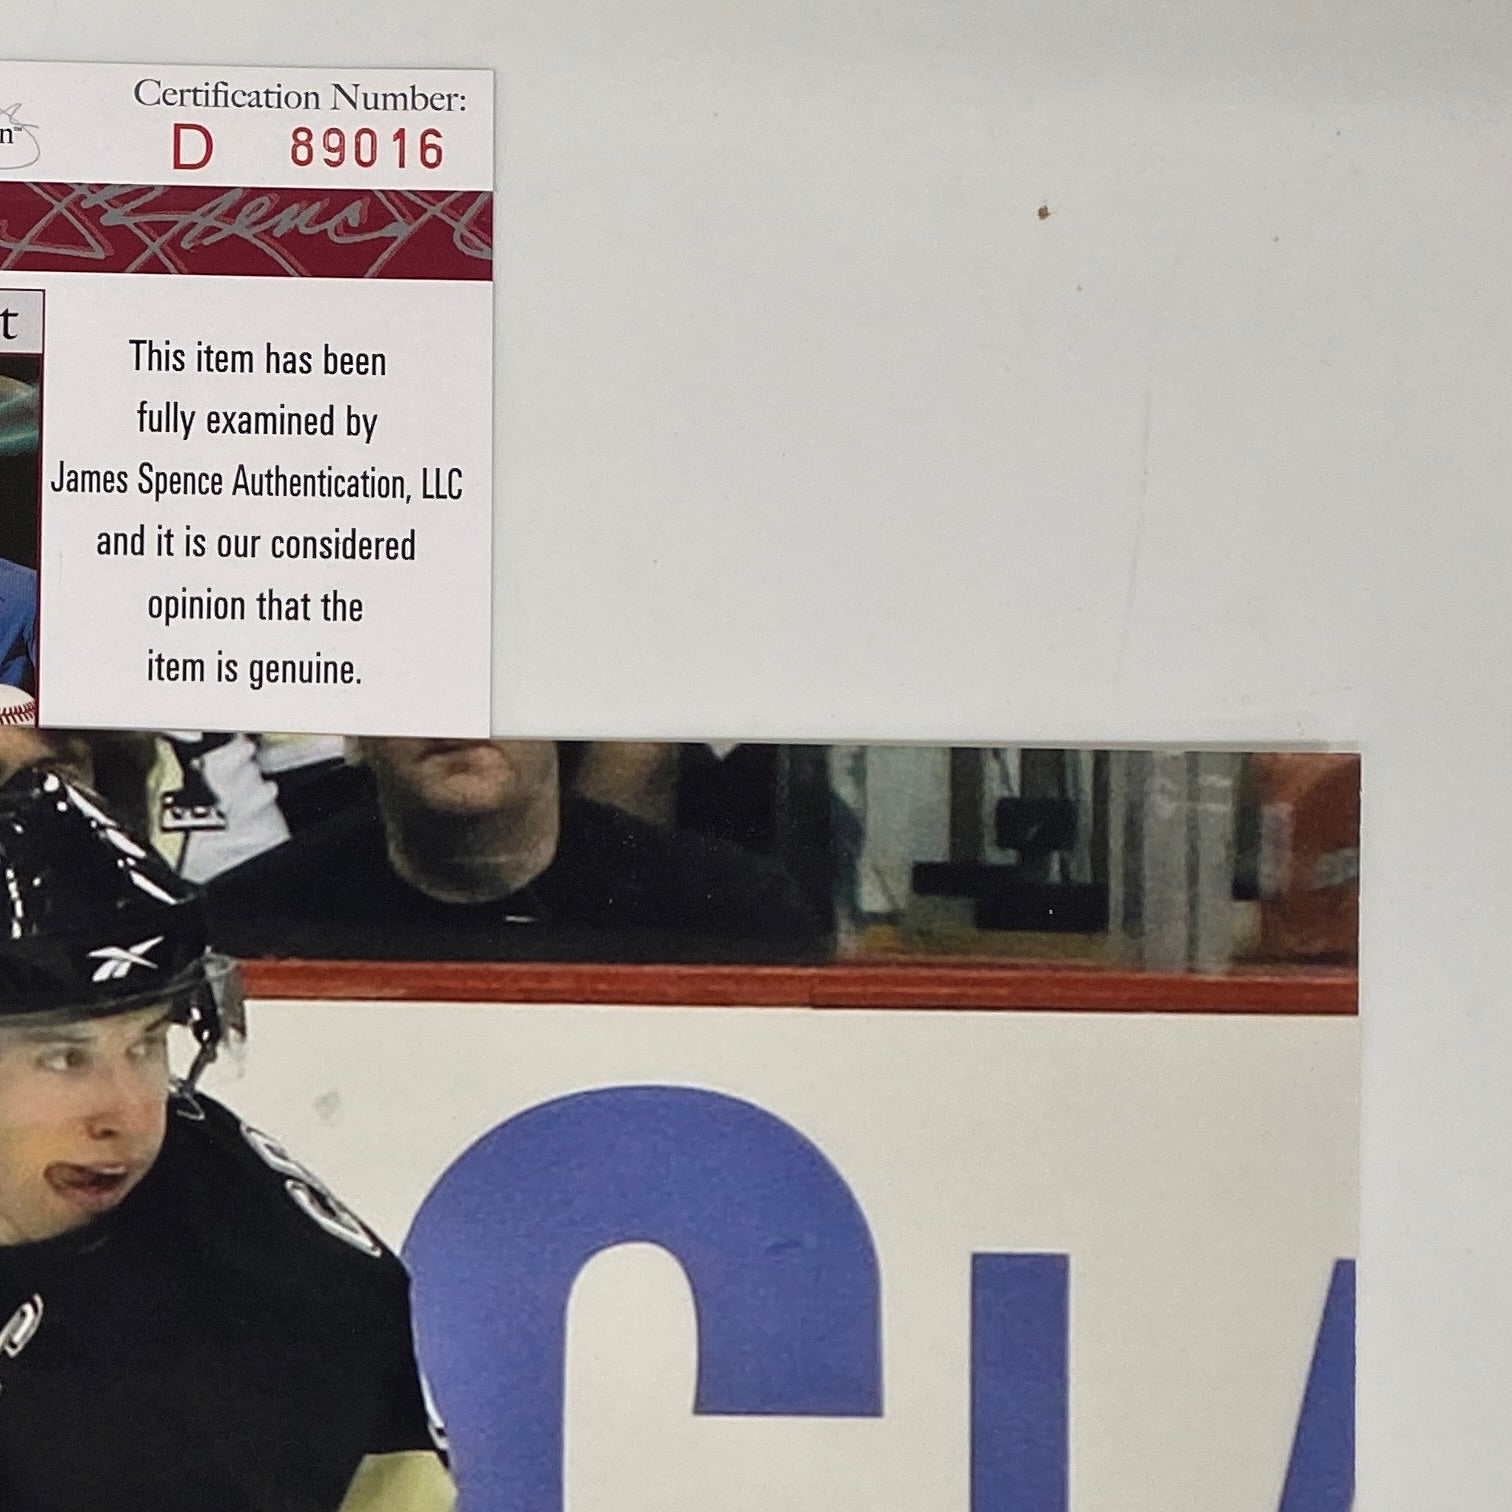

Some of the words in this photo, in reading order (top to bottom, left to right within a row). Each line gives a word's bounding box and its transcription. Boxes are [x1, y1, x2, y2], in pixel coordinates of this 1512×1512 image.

[135, 79, 320, 109] Certification
[331, 84, 465, 111] Number:
[174, 123, 213, 169] D
[292, 127, 442, 169] 89016
[129, 340, 185, 371] This
[198, 341, 253, 373] item
[267, 342, 311, 374] has
[324, 344, 385, 375] been
[137, 401, 195, 440] fully
[207, 404, 333, 435] examined
[347, 405, 377, 444] by
[51, 461, 128, 493] James
[138, 462, 222, 501] Spence
[232, 464, 411, 504] Authentication,
[423, 468, 462, 499] LLC
[97, 524, 144, 555] and
[158, 525, 174, 556] it
[186, 525, 205, 556] is
[218, 535, 260, 557] our
[272, 528, 415, 560] considered
[149, 587, 244, 626] opinion
[256, 589, 311, 620] that
[321, 590, 362, 621] the
[149, 649, 204, 681] item
[218, 650, 237, 682] is
[250, 652, 361, 690] genuine.
